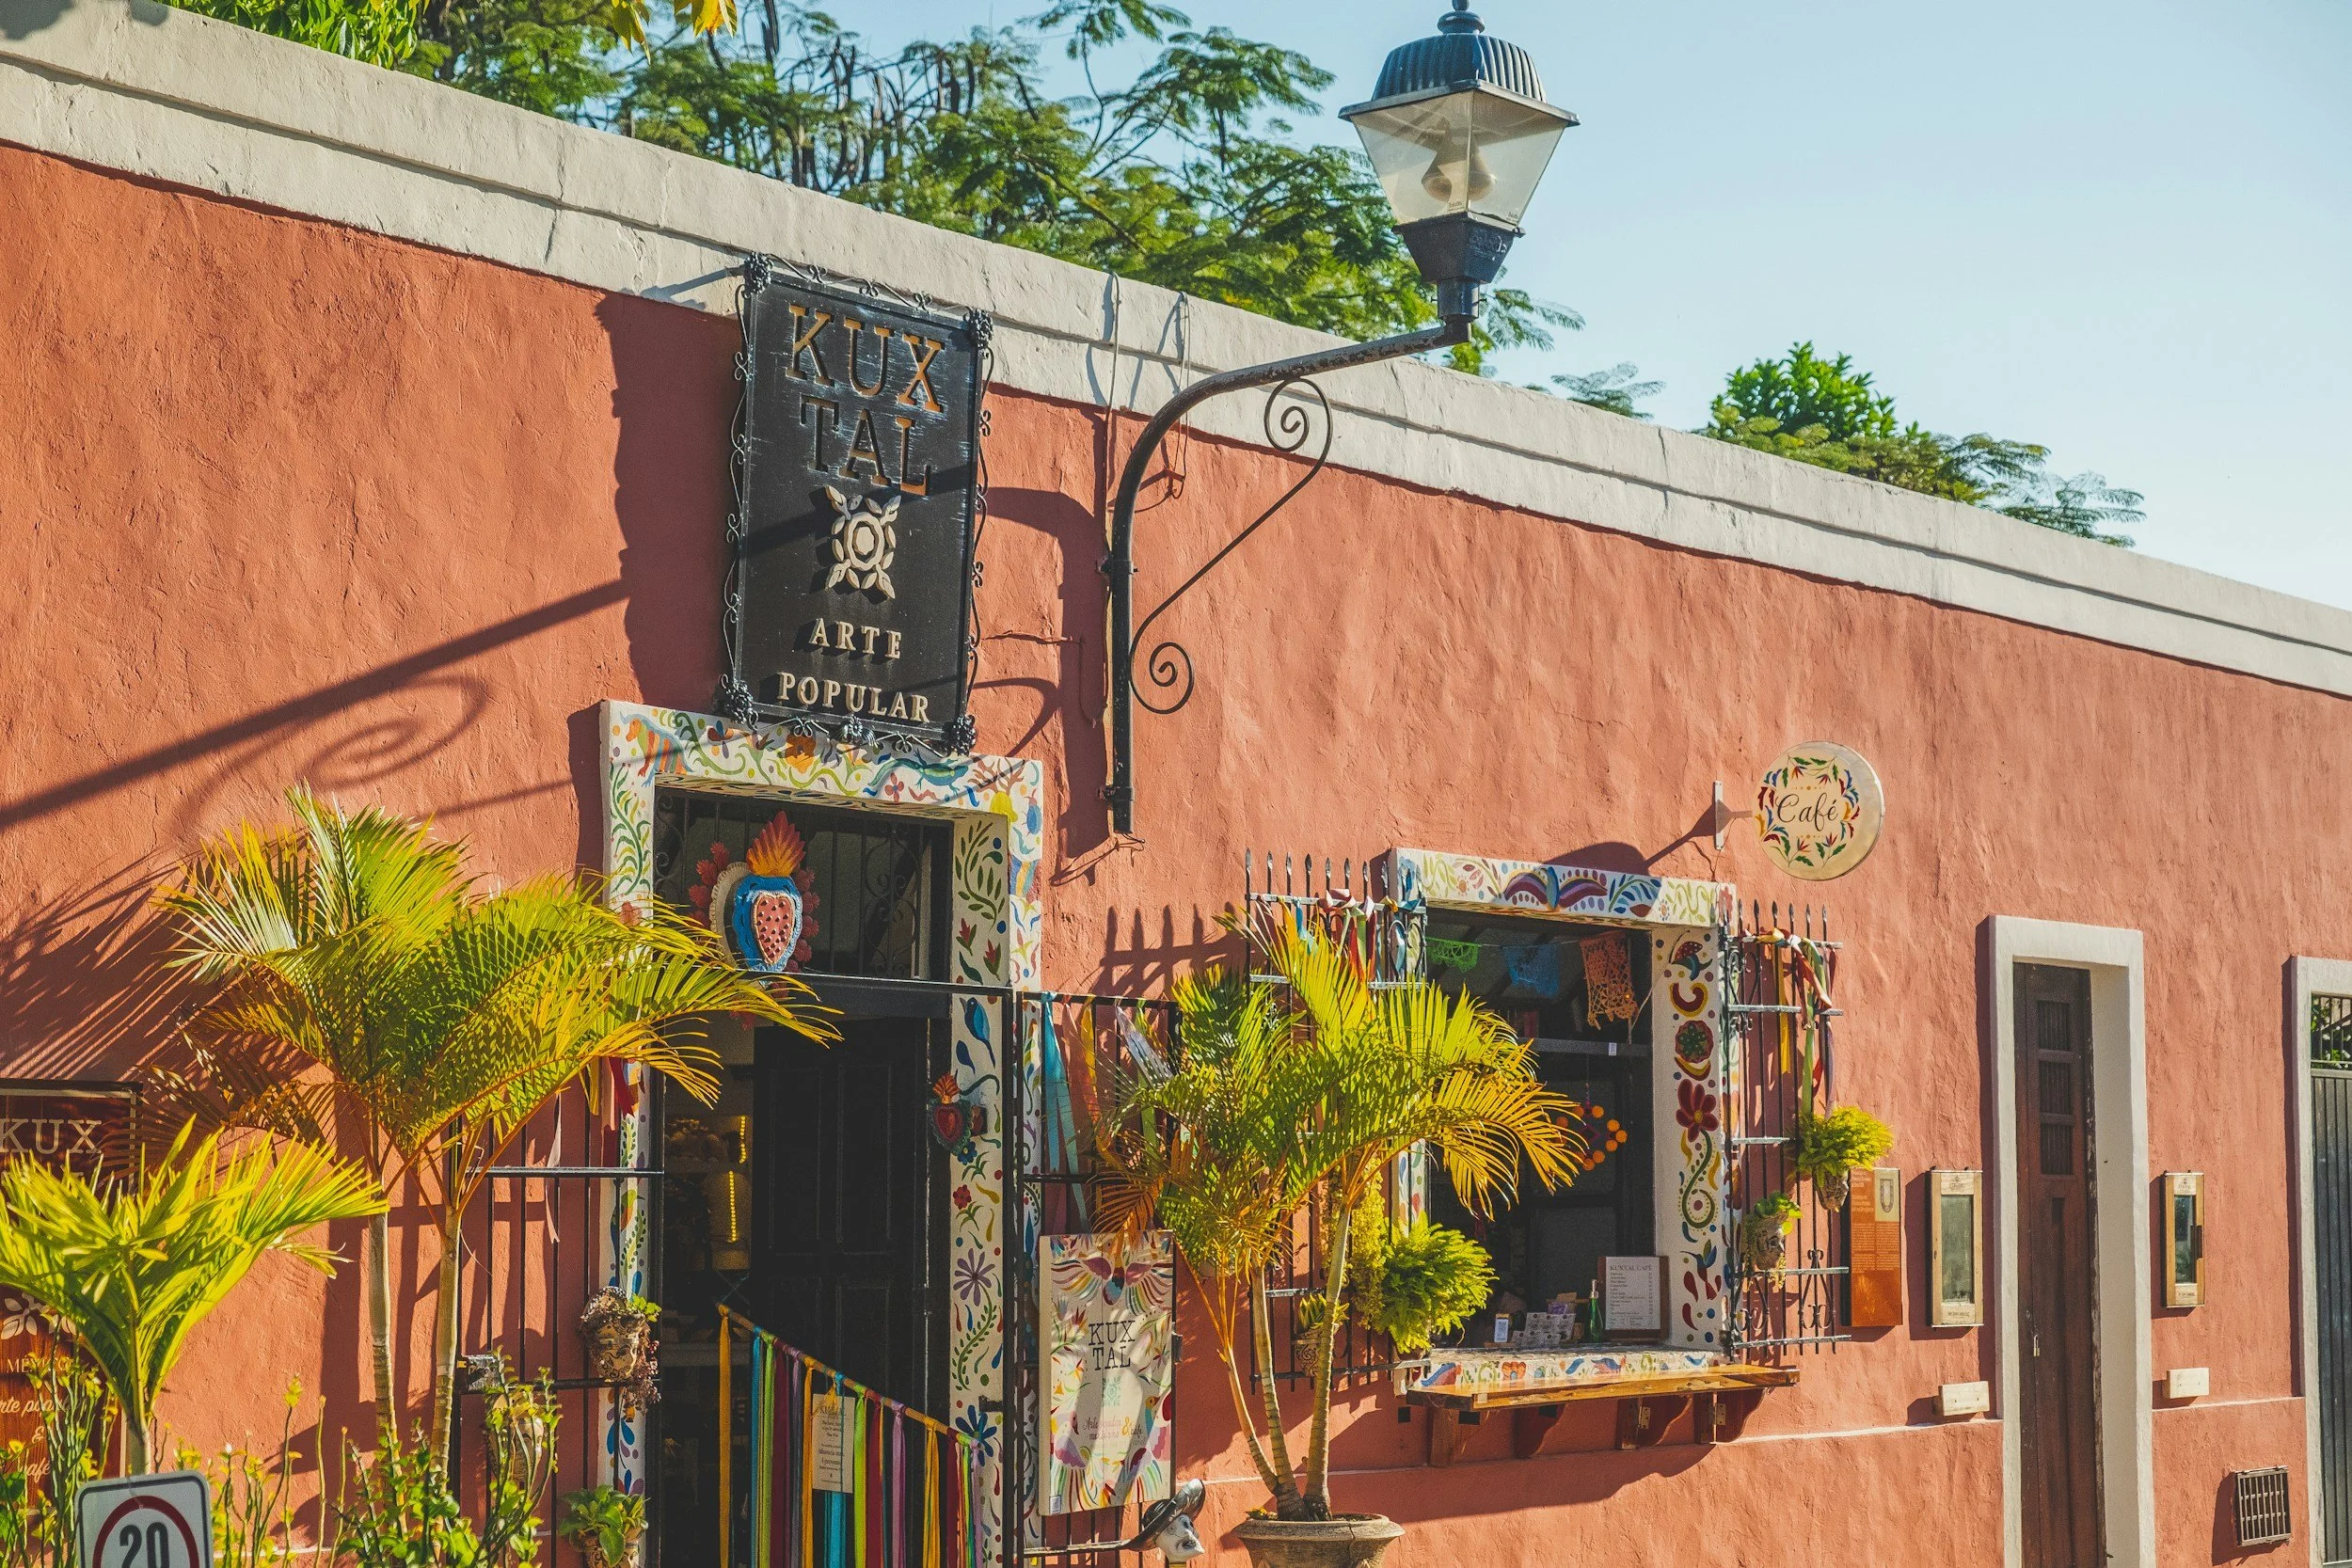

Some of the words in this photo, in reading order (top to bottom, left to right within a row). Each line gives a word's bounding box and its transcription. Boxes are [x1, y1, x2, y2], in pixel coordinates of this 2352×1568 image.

[786, 303, 945, 413] KUX
[800, 394, 931, 497] TAL
[808, 617, 901, 659] ARTE
[776, 672, 930, 723] POPULAR
[1774, 792, 1839, 832] Café
[0, 1118, 103, 1155] KUX
[1088, 1320, 1136, 1346] KUX
[1092, 1345, 1131, 1371] TAL
[31, 1425, 45, 1445] &
[119, 1521, 171, 1568] 20
